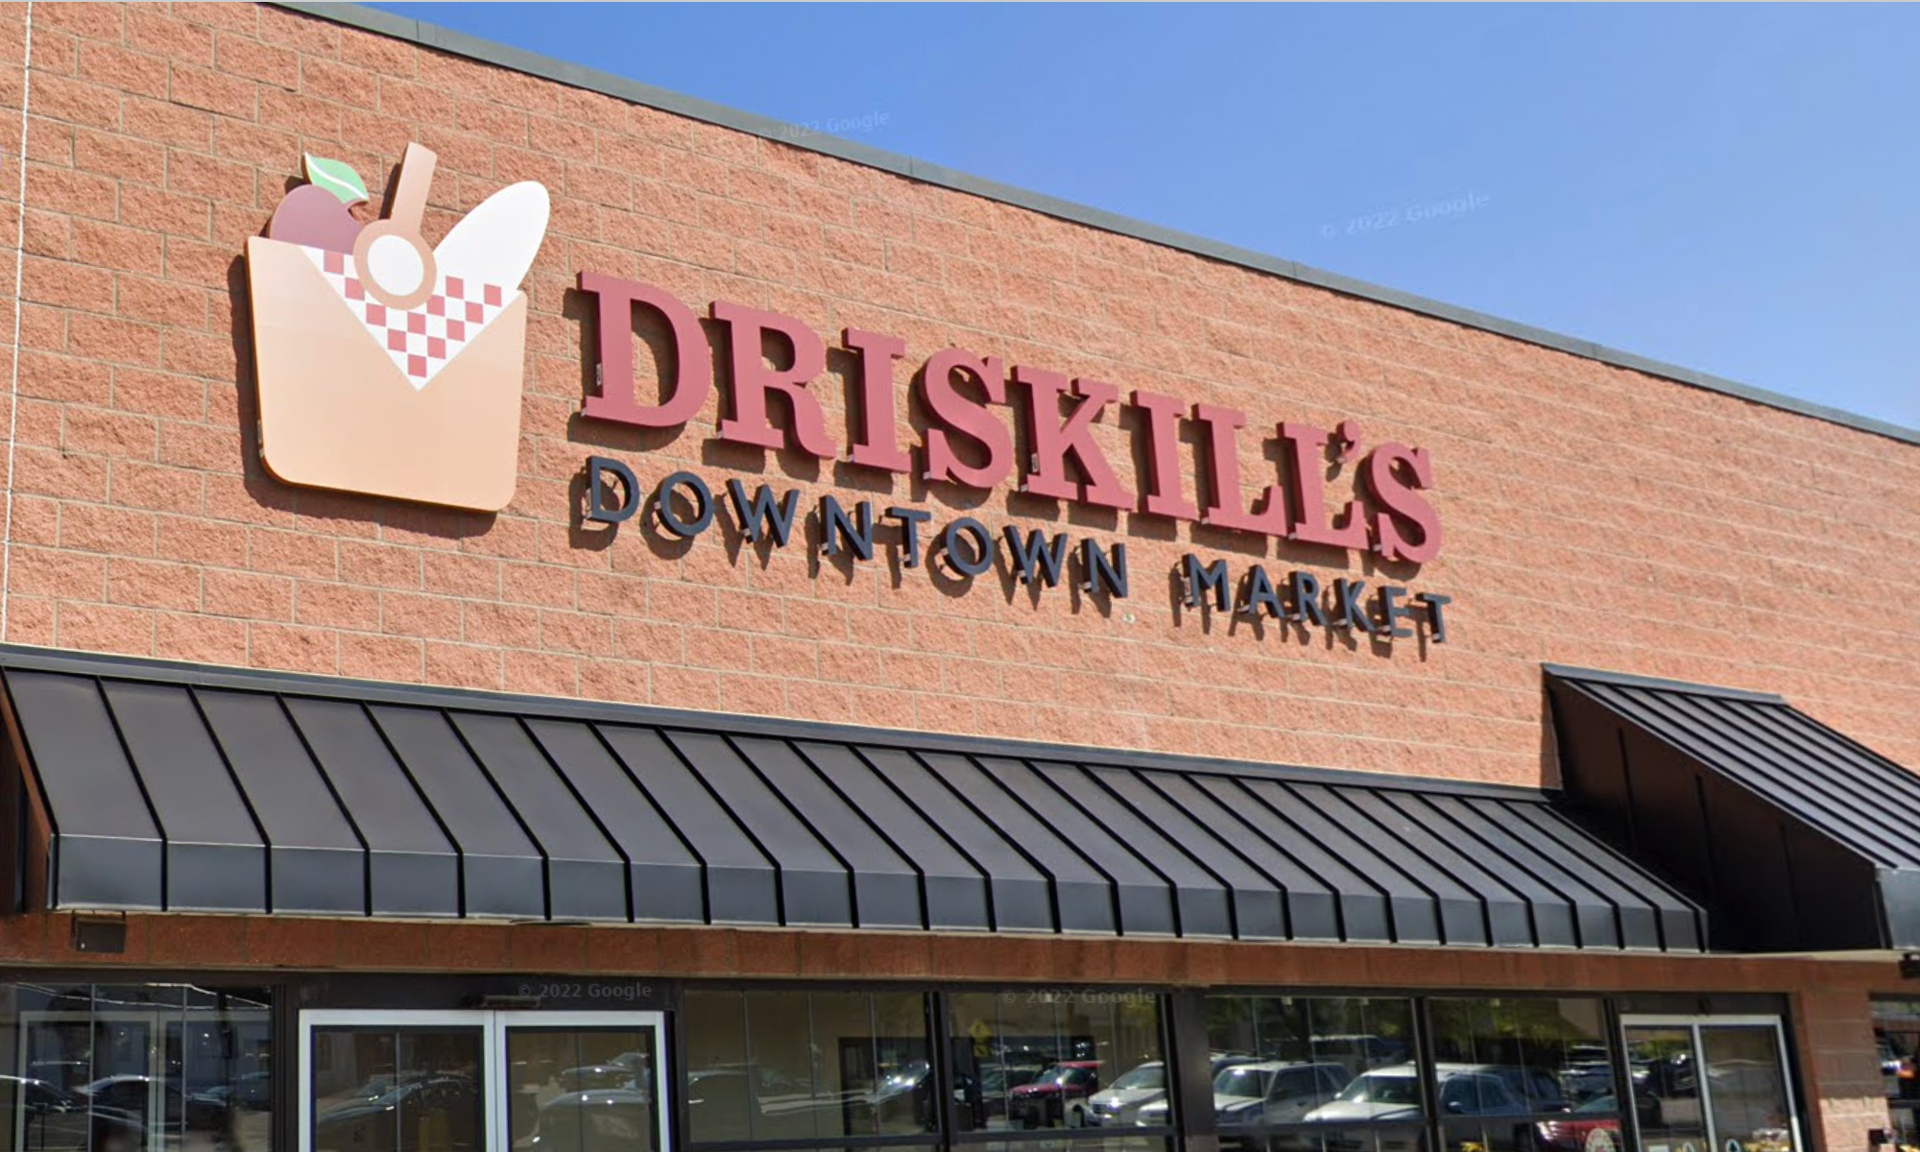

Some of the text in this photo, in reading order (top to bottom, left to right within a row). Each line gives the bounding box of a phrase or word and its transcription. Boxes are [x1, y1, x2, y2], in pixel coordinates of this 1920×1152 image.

[577, 270, 1442, 564] DRISKILL'S
[585, 455, 1452, 644] DOWNTOWN MARKET
